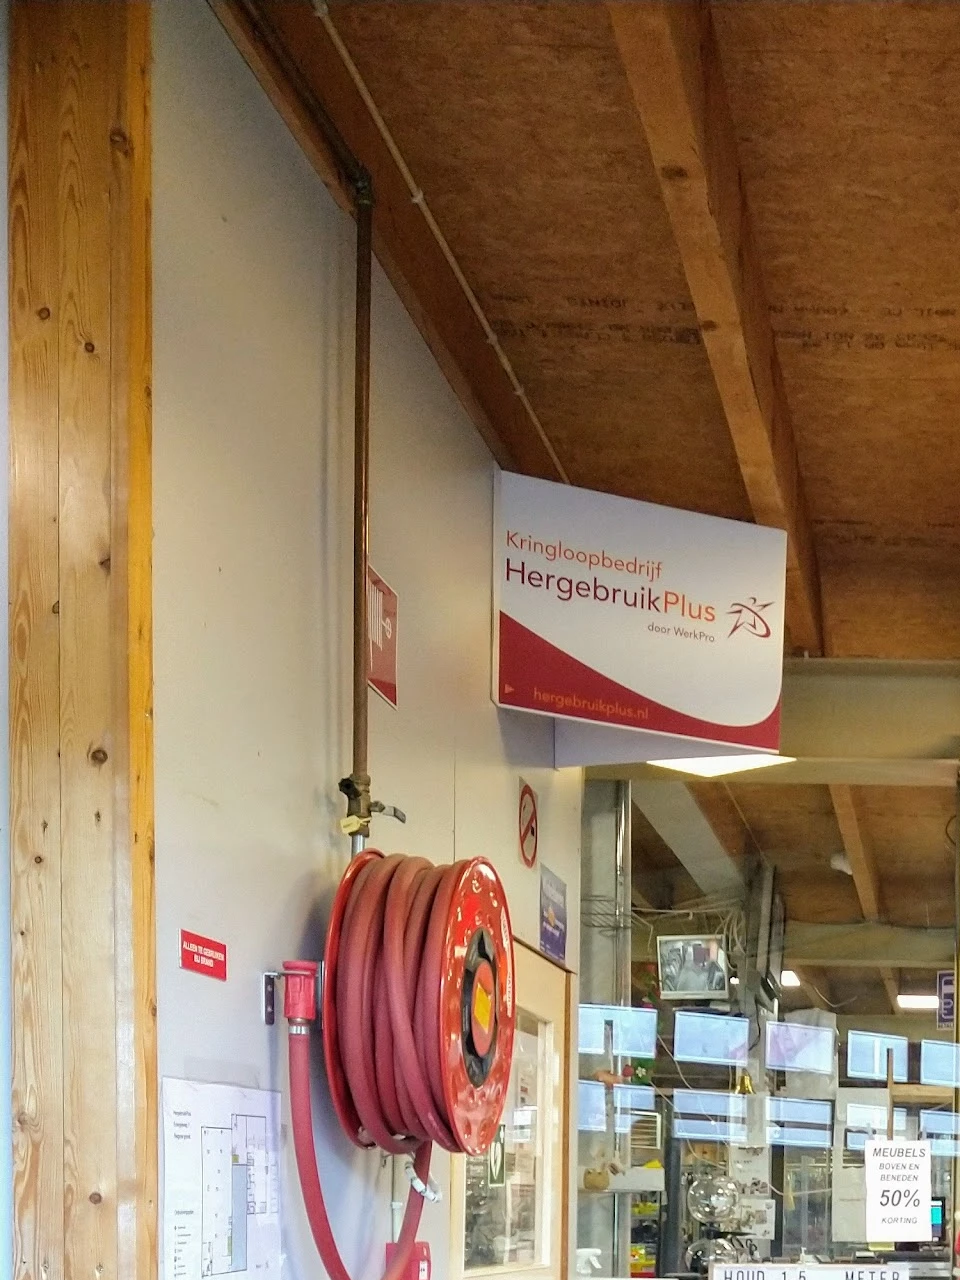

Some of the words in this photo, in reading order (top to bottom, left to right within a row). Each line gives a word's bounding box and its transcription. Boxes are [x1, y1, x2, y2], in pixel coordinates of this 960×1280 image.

[506, 530, 663, 582] Kringloopbedrijf
[506, 558, 716, 622] HergebruikPlus
[647, 622, 671, 635] door
[673, 627, 715, 643] WerkPro
[534, 687, 649, 719] hergebruikplus.nl
[872, 1148, 926, 1157] MEUBELS
[879, 1189, 920, 1207] 50%
